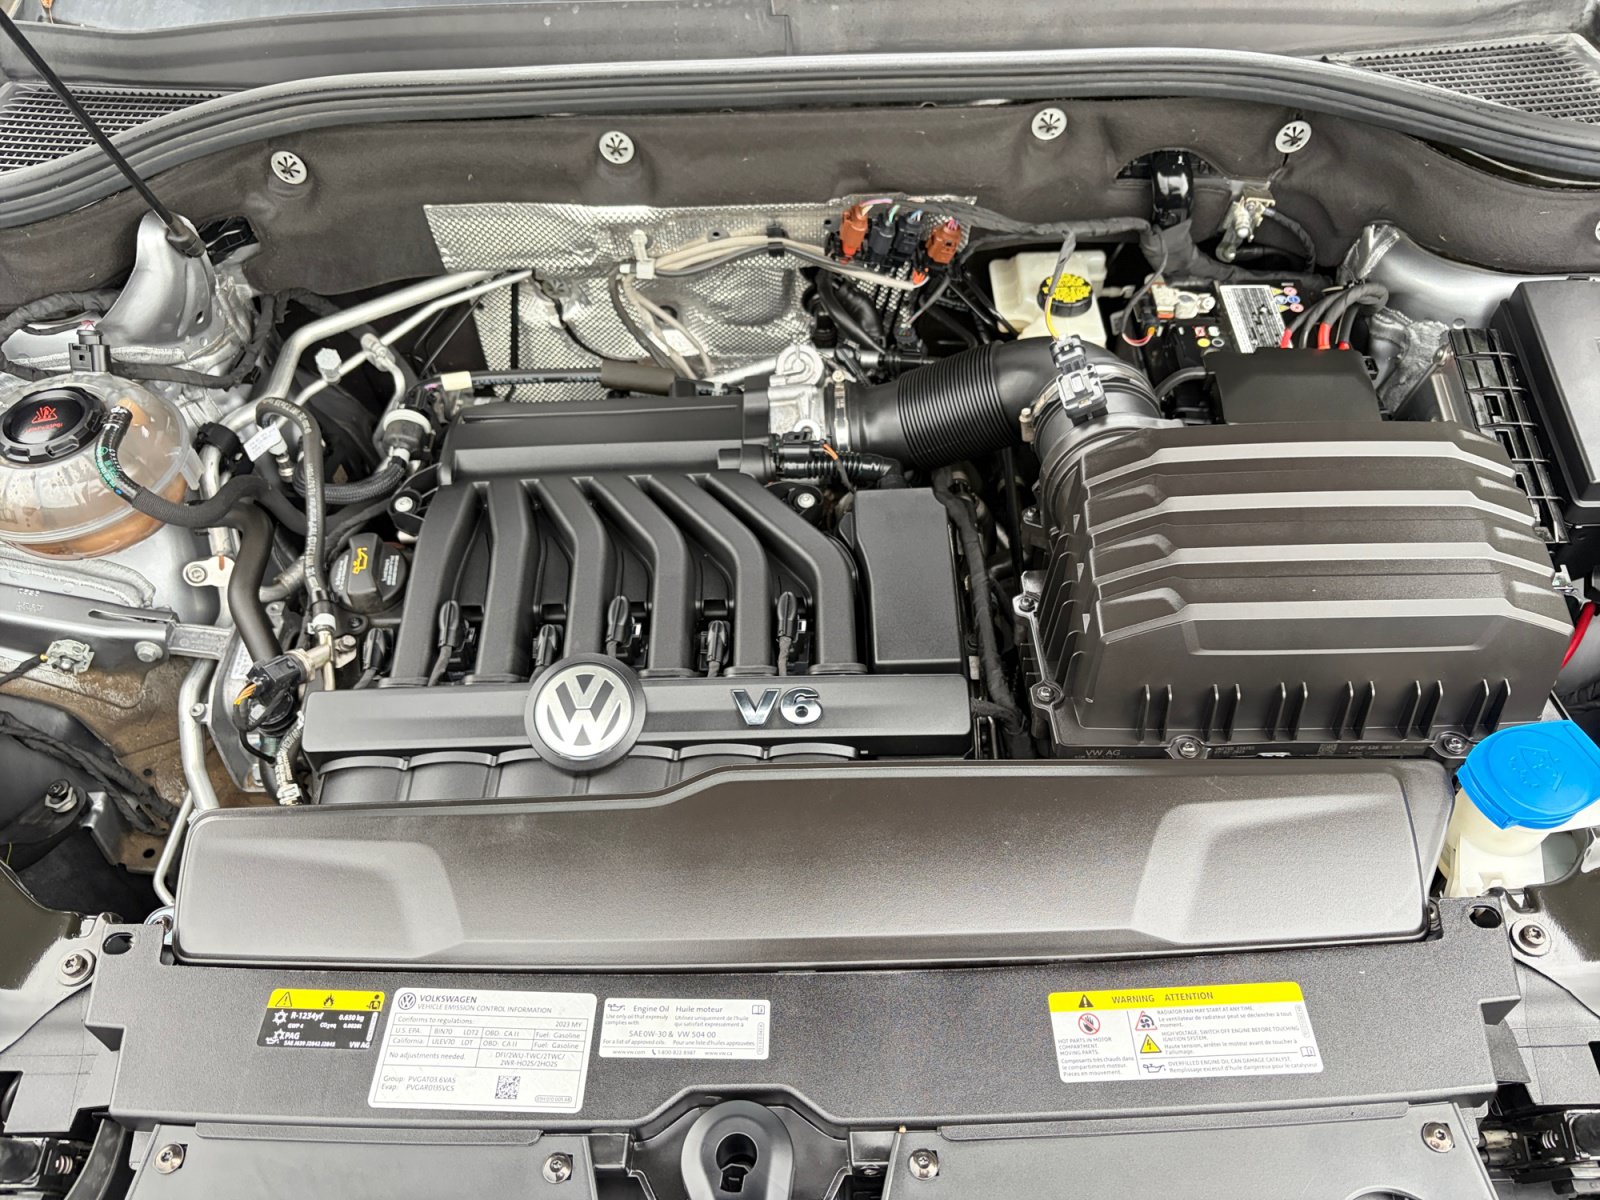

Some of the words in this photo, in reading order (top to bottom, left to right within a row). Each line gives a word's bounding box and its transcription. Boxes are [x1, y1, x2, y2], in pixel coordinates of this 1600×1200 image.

[730, 687, 822, 726] V6
[420, 994, 477, 1003] VOLKSWAGEN
[1111, 995, 1155, 1004] WARNING
[1165, 992, 1214, 1001] ATTENTION
[633, 1005, 658, 1014] Engine
[675, 1005, 695, 1013] Huile
[290, 1012, 324, 1021] R-1234yf
[628, 1030, 643, 1038] SAE
[643, 1030, 668, 1038] 0W-30
[399, 1052, 440, 1060] adjustments
